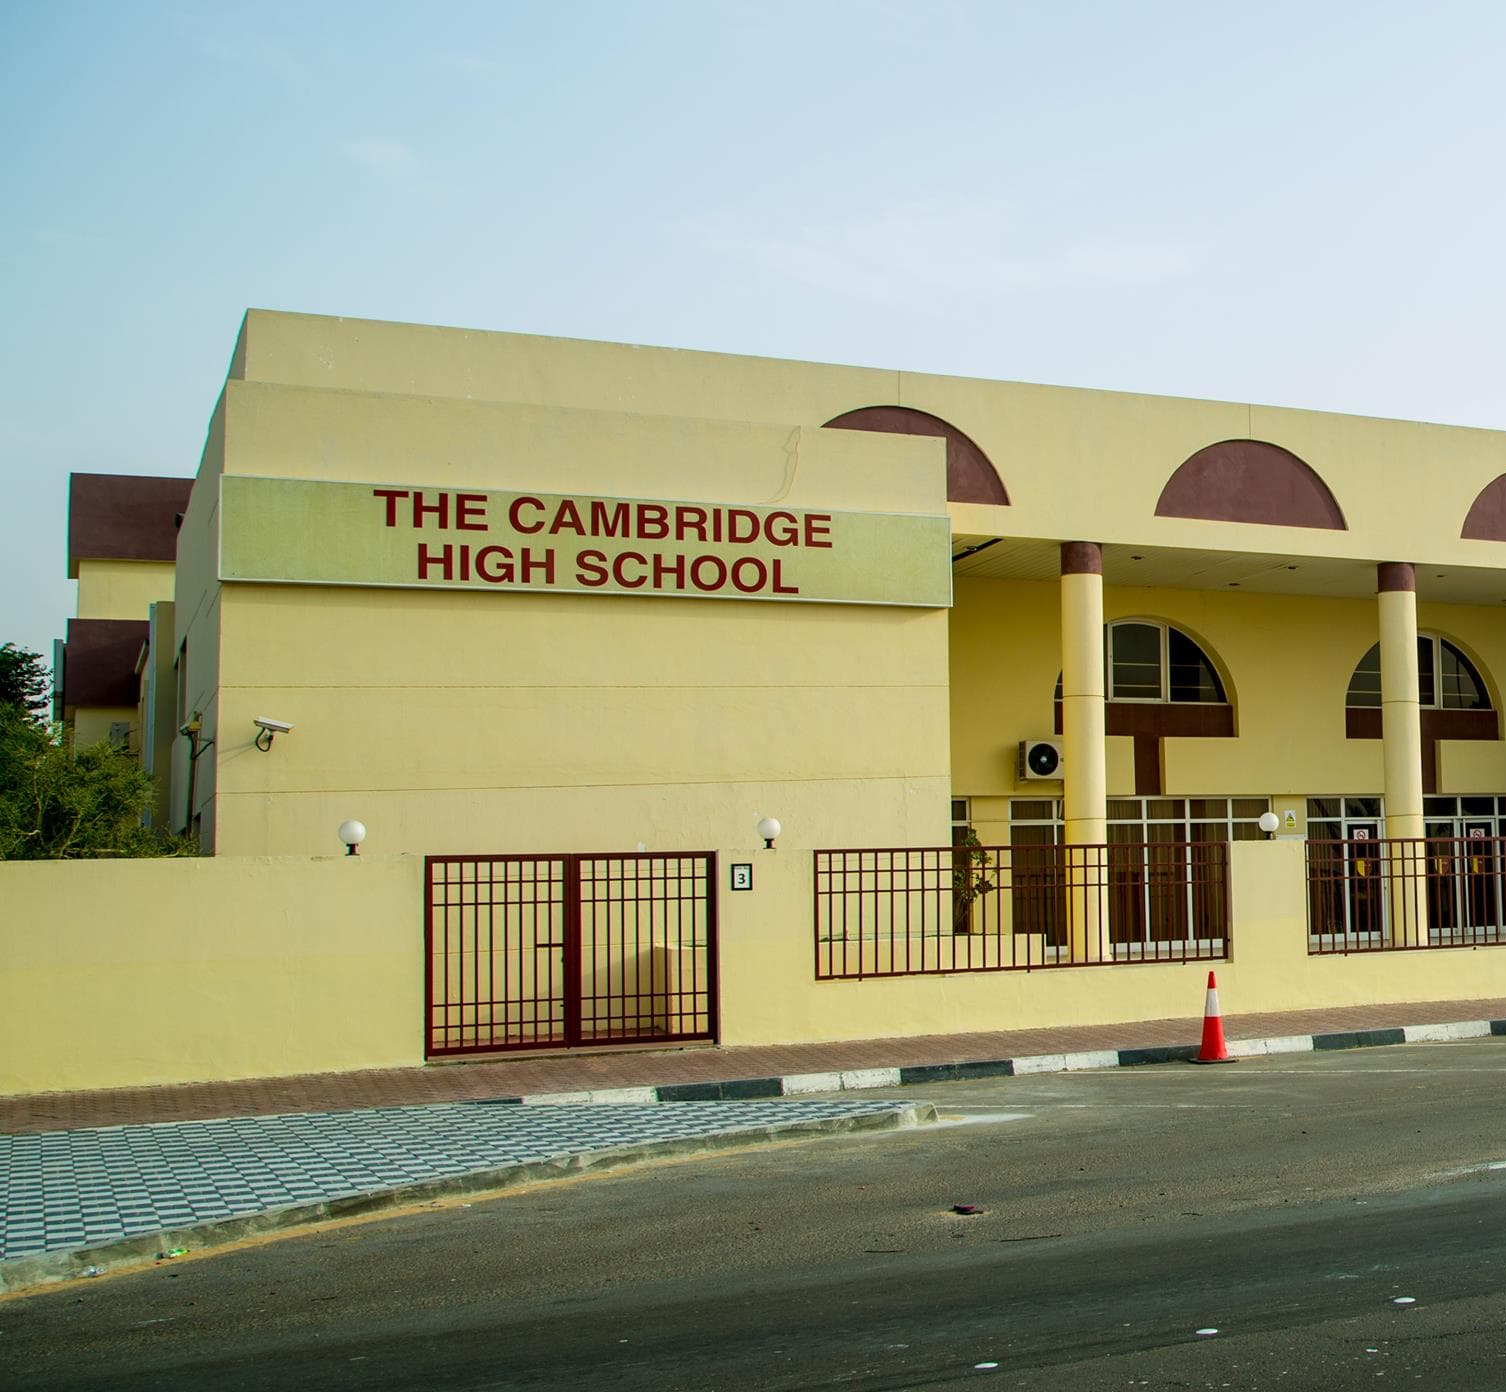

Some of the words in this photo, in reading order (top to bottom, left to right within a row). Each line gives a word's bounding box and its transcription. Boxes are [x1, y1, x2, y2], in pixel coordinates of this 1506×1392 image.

[375, 489, 489, 531] THE
[509, 495, 833, 549] CAMBRIDGE
[418, 544, 556, 586] HIGH
[576, 550, 800, 595] SCHOOL
[738, 874, 745, 884] 3
